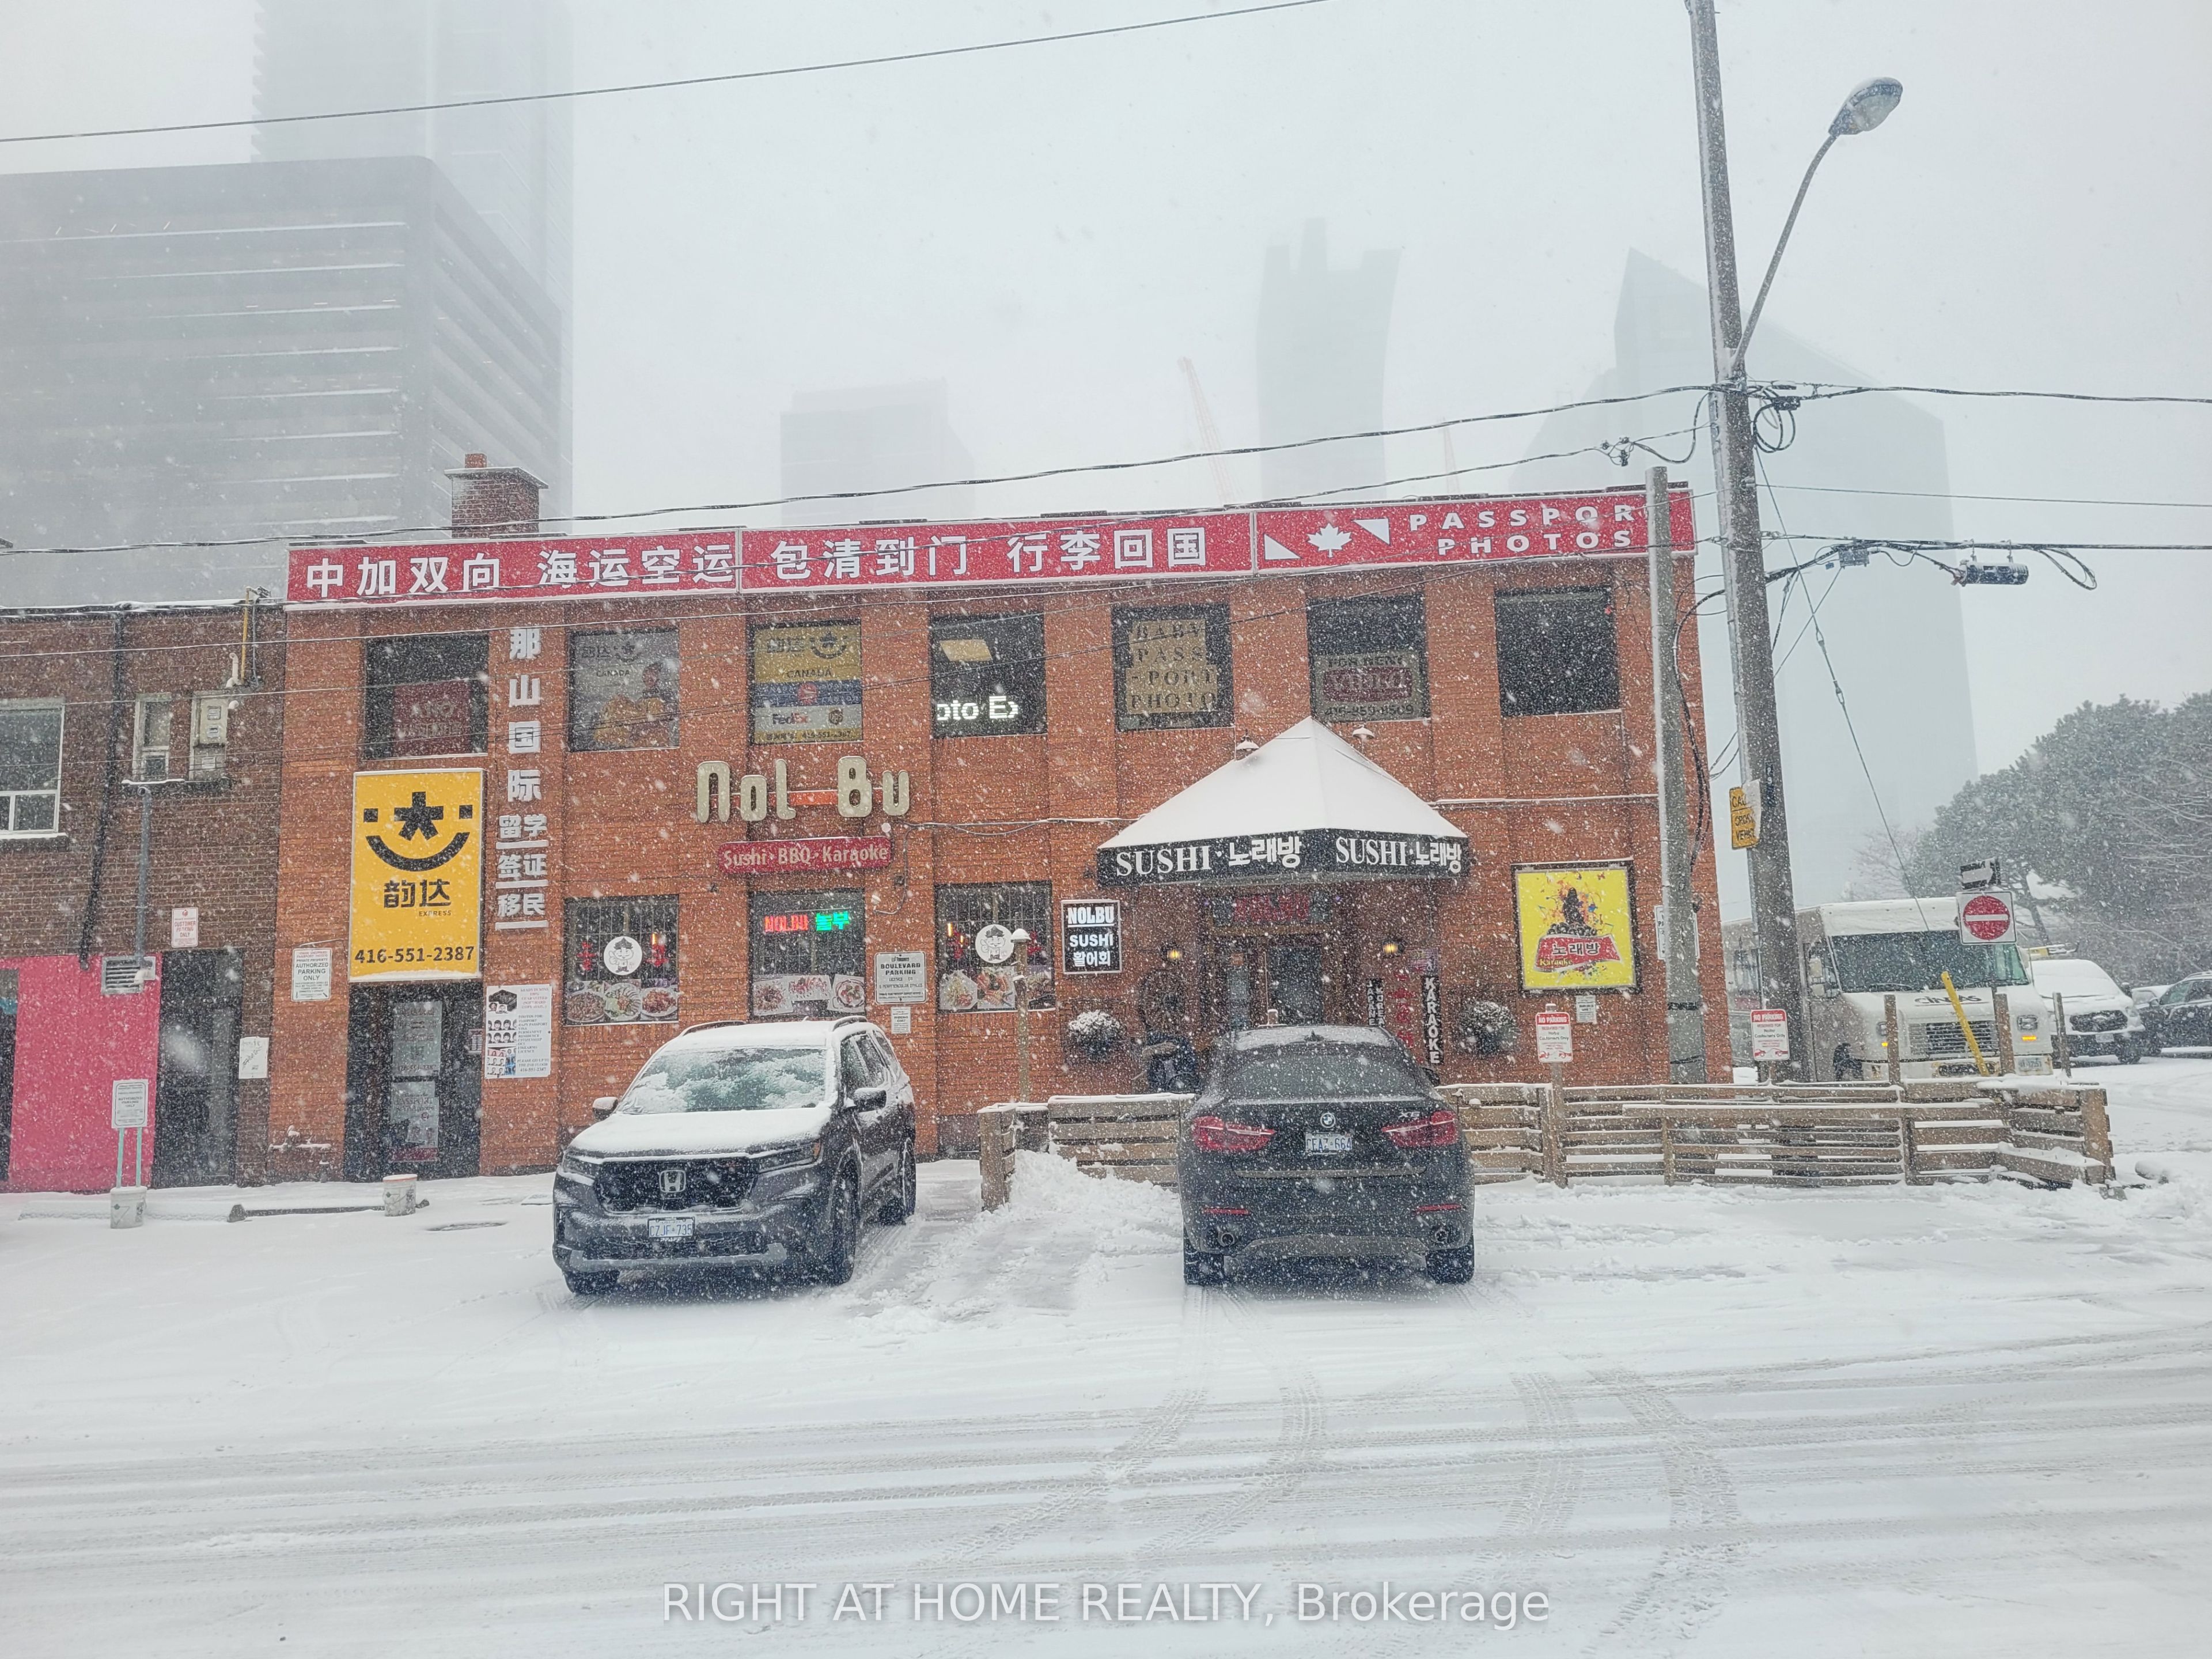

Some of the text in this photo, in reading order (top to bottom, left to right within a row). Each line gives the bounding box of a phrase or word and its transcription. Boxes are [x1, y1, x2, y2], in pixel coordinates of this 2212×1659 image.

[1410, 504, 1648, 531] PASSPOR
[1438, 531, 1631, 555] PHOTOS
[308, 527, 1206, 597] 中加双向 海运空运 包清到门 行李回国
[1138, 646, 1203, 662] PASS
[786, 668, 832, 679] CANADA
[837, 755, 910, 818] Bu
[498, 814, 547, 839] 留学
[498, 854, 547, 878] 签证
[1116, 836, 1302, 876] SUSHI 노래방
[1335, 837, 1462, 873] SUSHI 노래방
[383, 879, 452, 908] 韵达
[497, 893, 546, 918] 移民
[1067, 906, 1115, 924] NOLBU
[1069, 934, 1114, 947] SUSHI
[1552, 942, 1601, 956] 노래방
[354, 946, 475, 964] 416-551-2387
[1073, 950, 1111, 967] 활어회
[1367, 980, 1376, 1026] JAPANE
[1376, 986, 1385, 1027] KOREA
[1914, 995, 1982, 1004] CINAS
[1425, 977, 1440, 1064] KARAOKE
